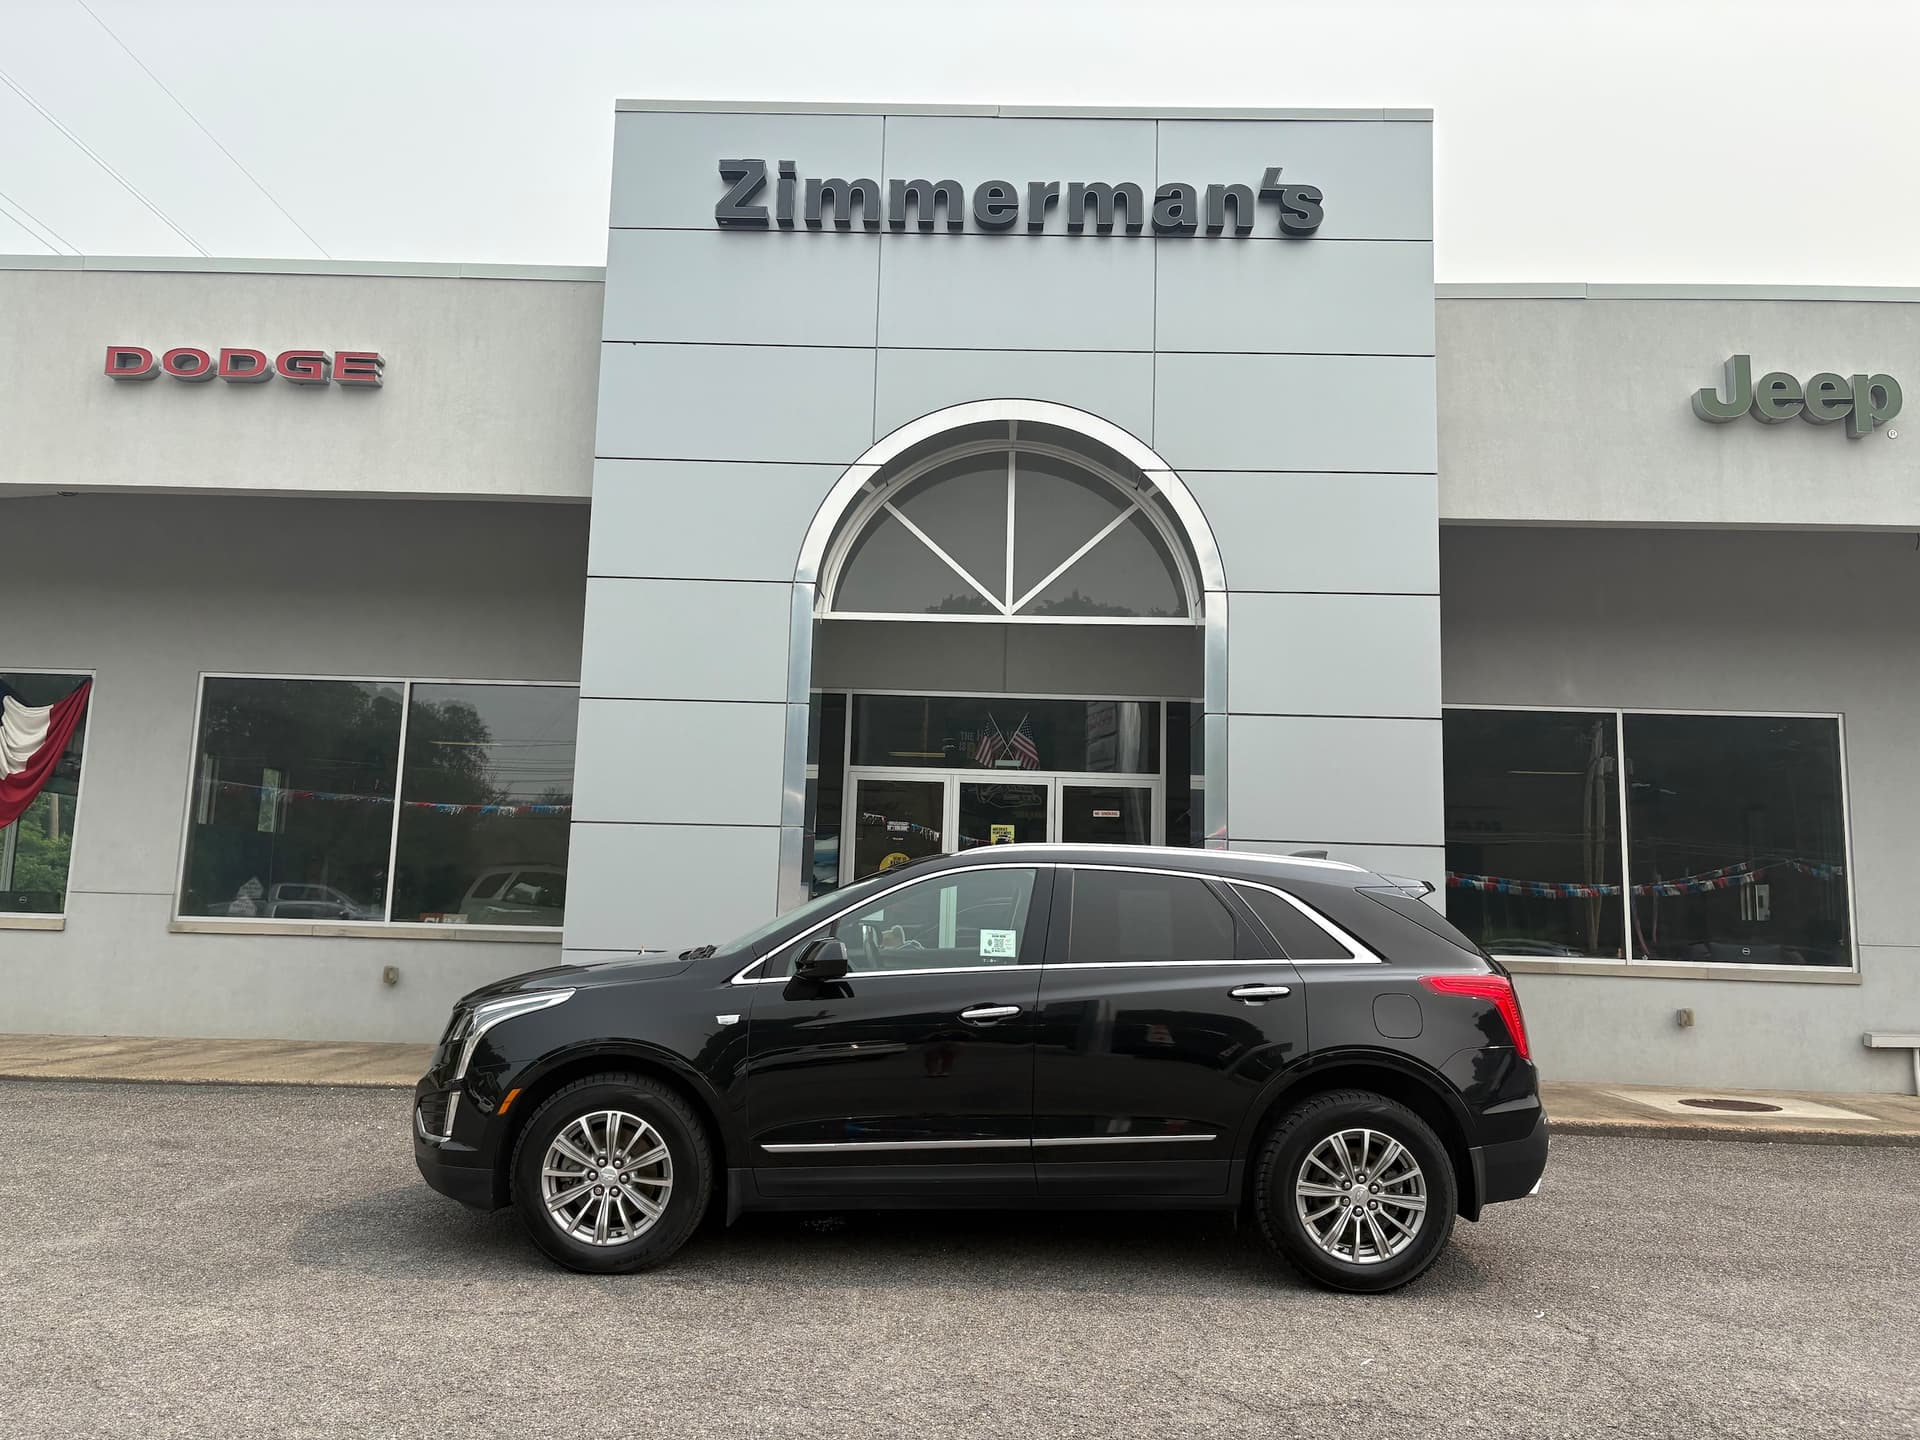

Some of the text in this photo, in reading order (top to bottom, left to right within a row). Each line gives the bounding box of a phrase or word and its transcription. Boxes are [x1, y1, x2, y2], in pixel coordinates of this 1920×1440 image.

[714, 159, 1324, 236] Zimmerman's
[104, 346, 385, 387] DODGE
[1691, 354, 1903, 438] Jeep
